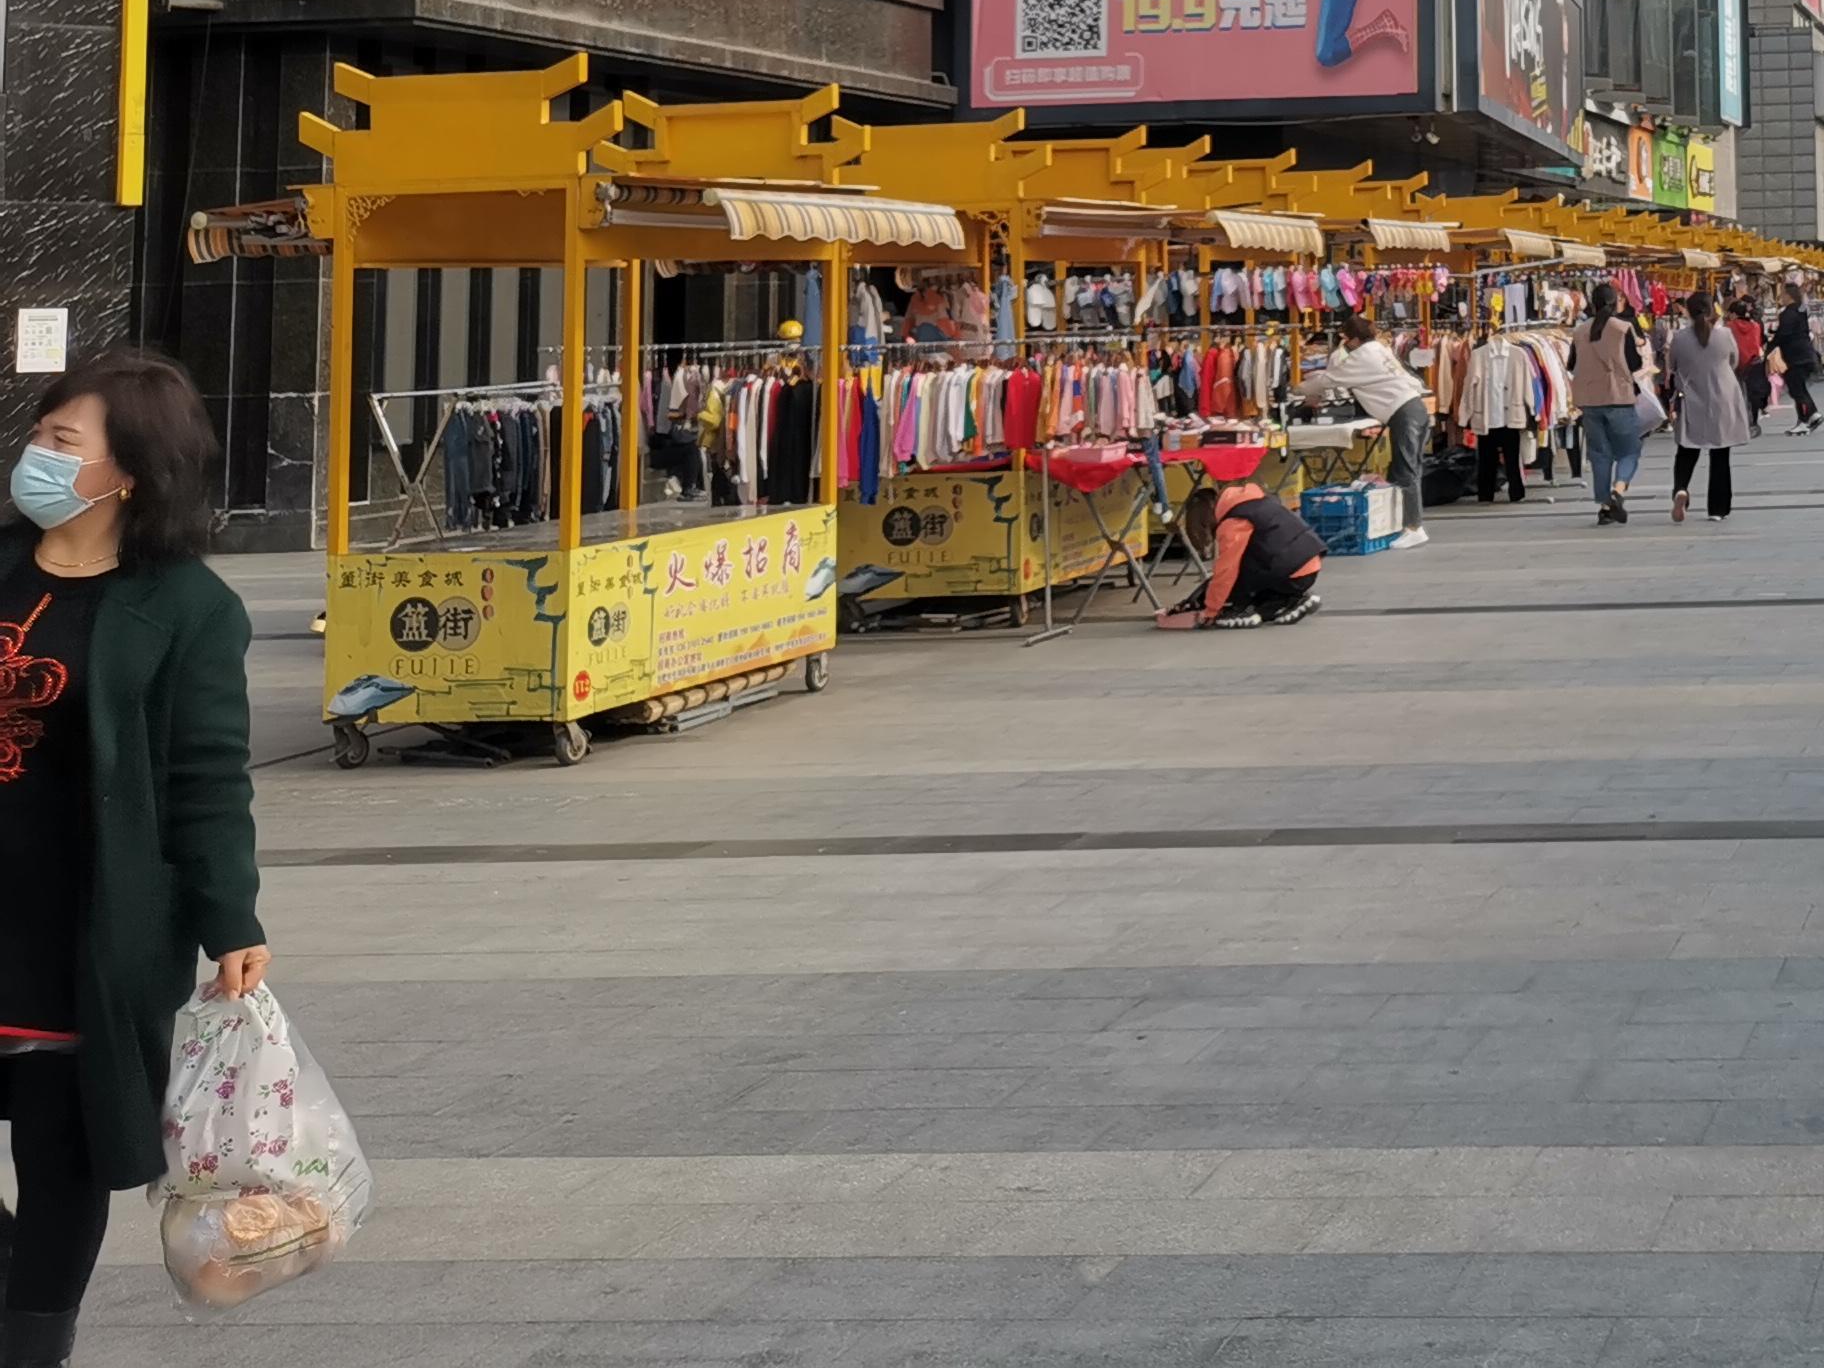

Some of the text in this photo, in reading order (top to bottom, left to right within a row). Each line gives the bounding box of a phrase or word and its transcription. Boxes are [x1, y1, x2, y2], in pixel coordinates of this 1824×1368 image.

[665, 521, 802, 596] 火爆招商
[393, 658, 475, 676] FUJIE
